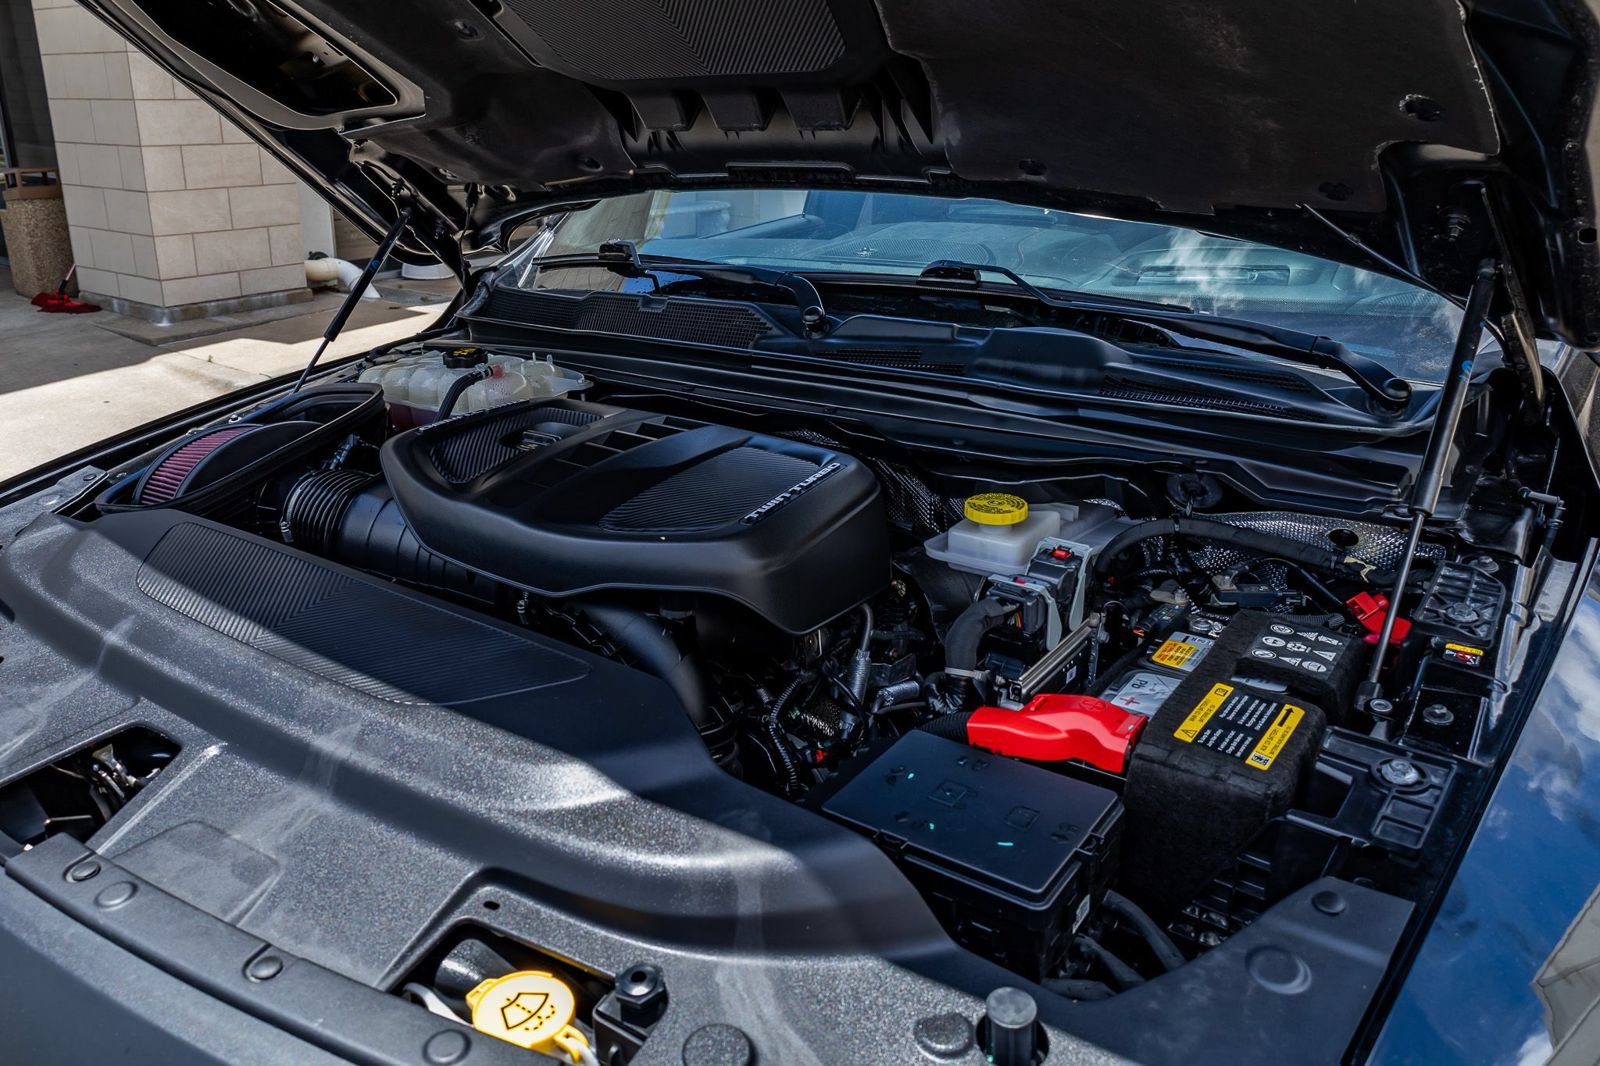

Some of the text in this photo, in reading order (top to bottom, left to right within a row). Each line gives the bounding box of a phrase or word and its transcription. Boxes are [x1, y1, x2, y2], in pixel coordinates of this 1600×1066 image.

[744, 462, 841, 521] TWIN TURBO
[1131, 678, 1148, 689] Pb
